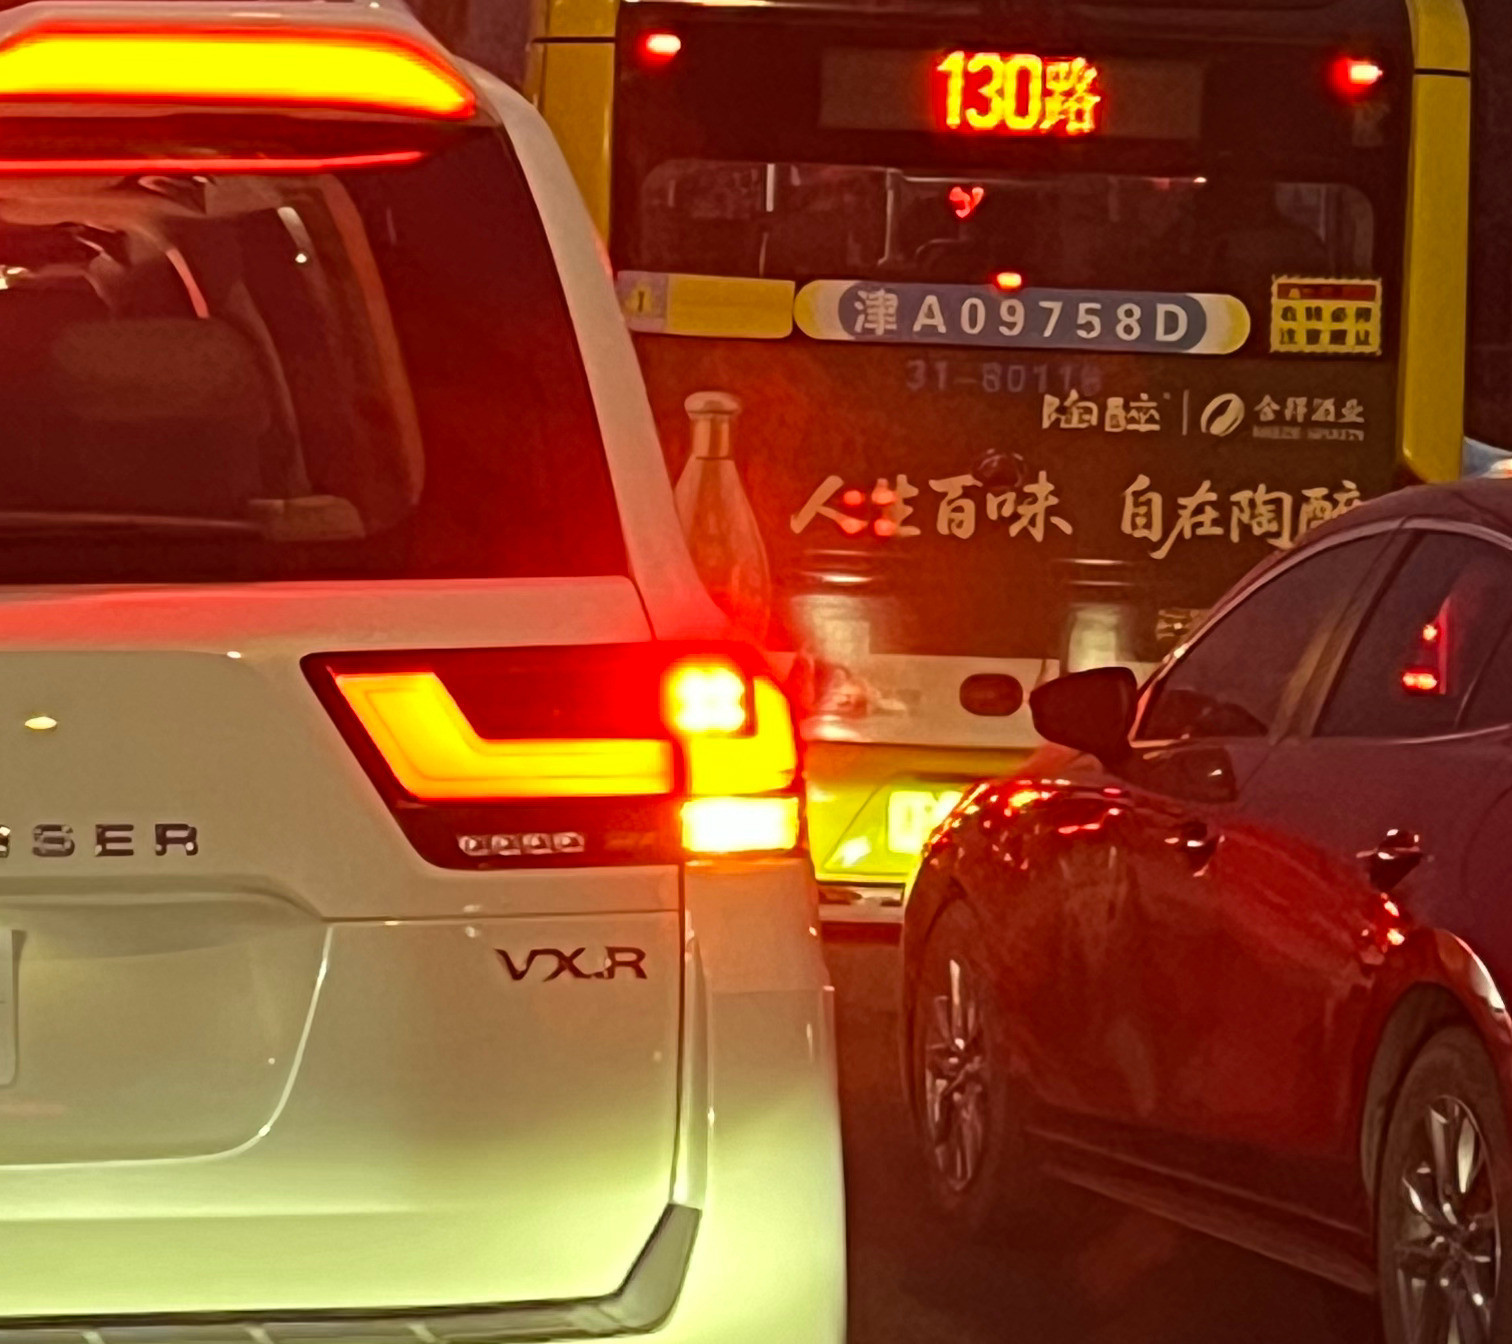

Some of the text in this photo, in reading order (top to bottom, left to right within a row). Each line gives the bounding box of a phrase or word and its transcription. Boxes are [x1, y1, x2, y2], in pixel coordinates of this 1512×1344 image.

[936, 50, 1102, 136] 130路
[789, 469, 1074, 543] 人生百味
